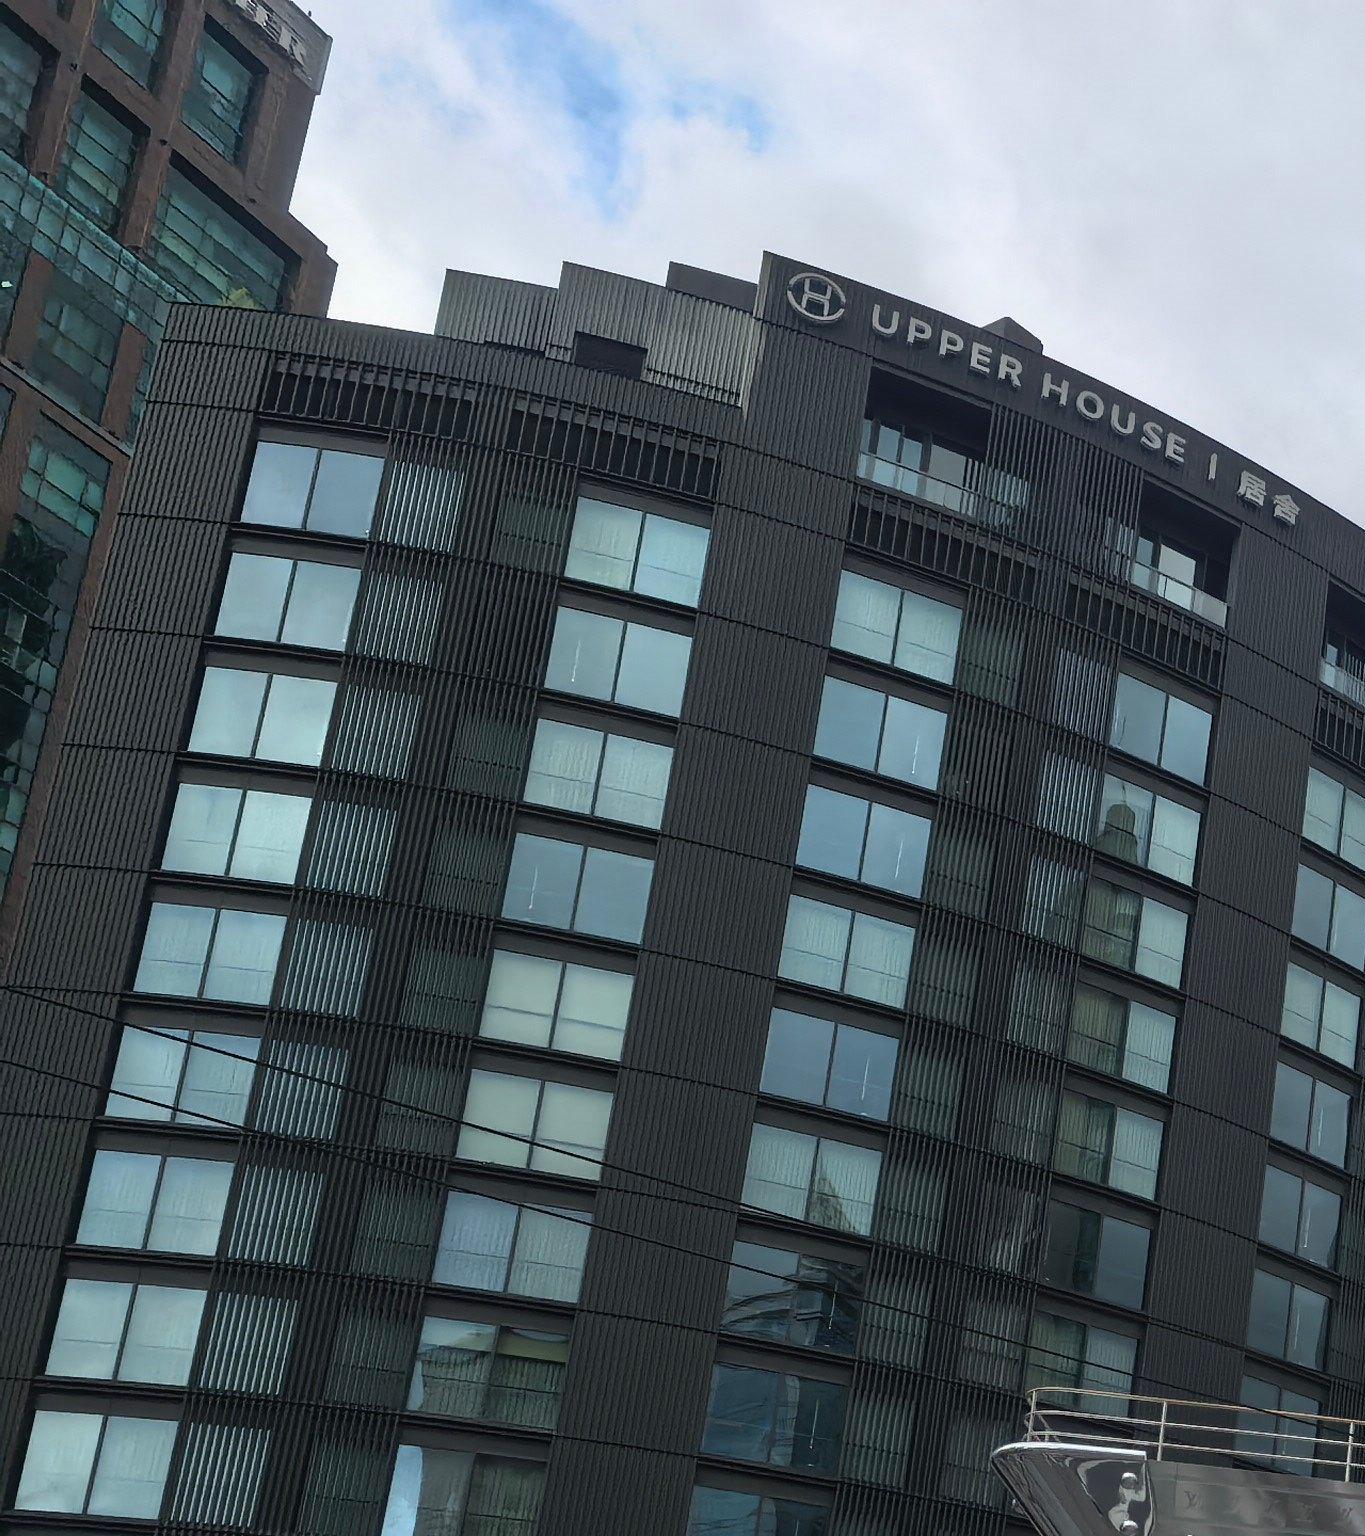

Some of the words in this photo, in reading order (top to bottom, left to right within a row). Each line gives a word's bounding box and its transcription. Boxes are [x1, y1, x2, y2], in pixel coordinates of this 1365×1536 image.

[871, 302, 1023, 388] UPPER
[1040, 371, 1186, 463] HOUSE
[1236, 468, 1300, 527] 居舍
